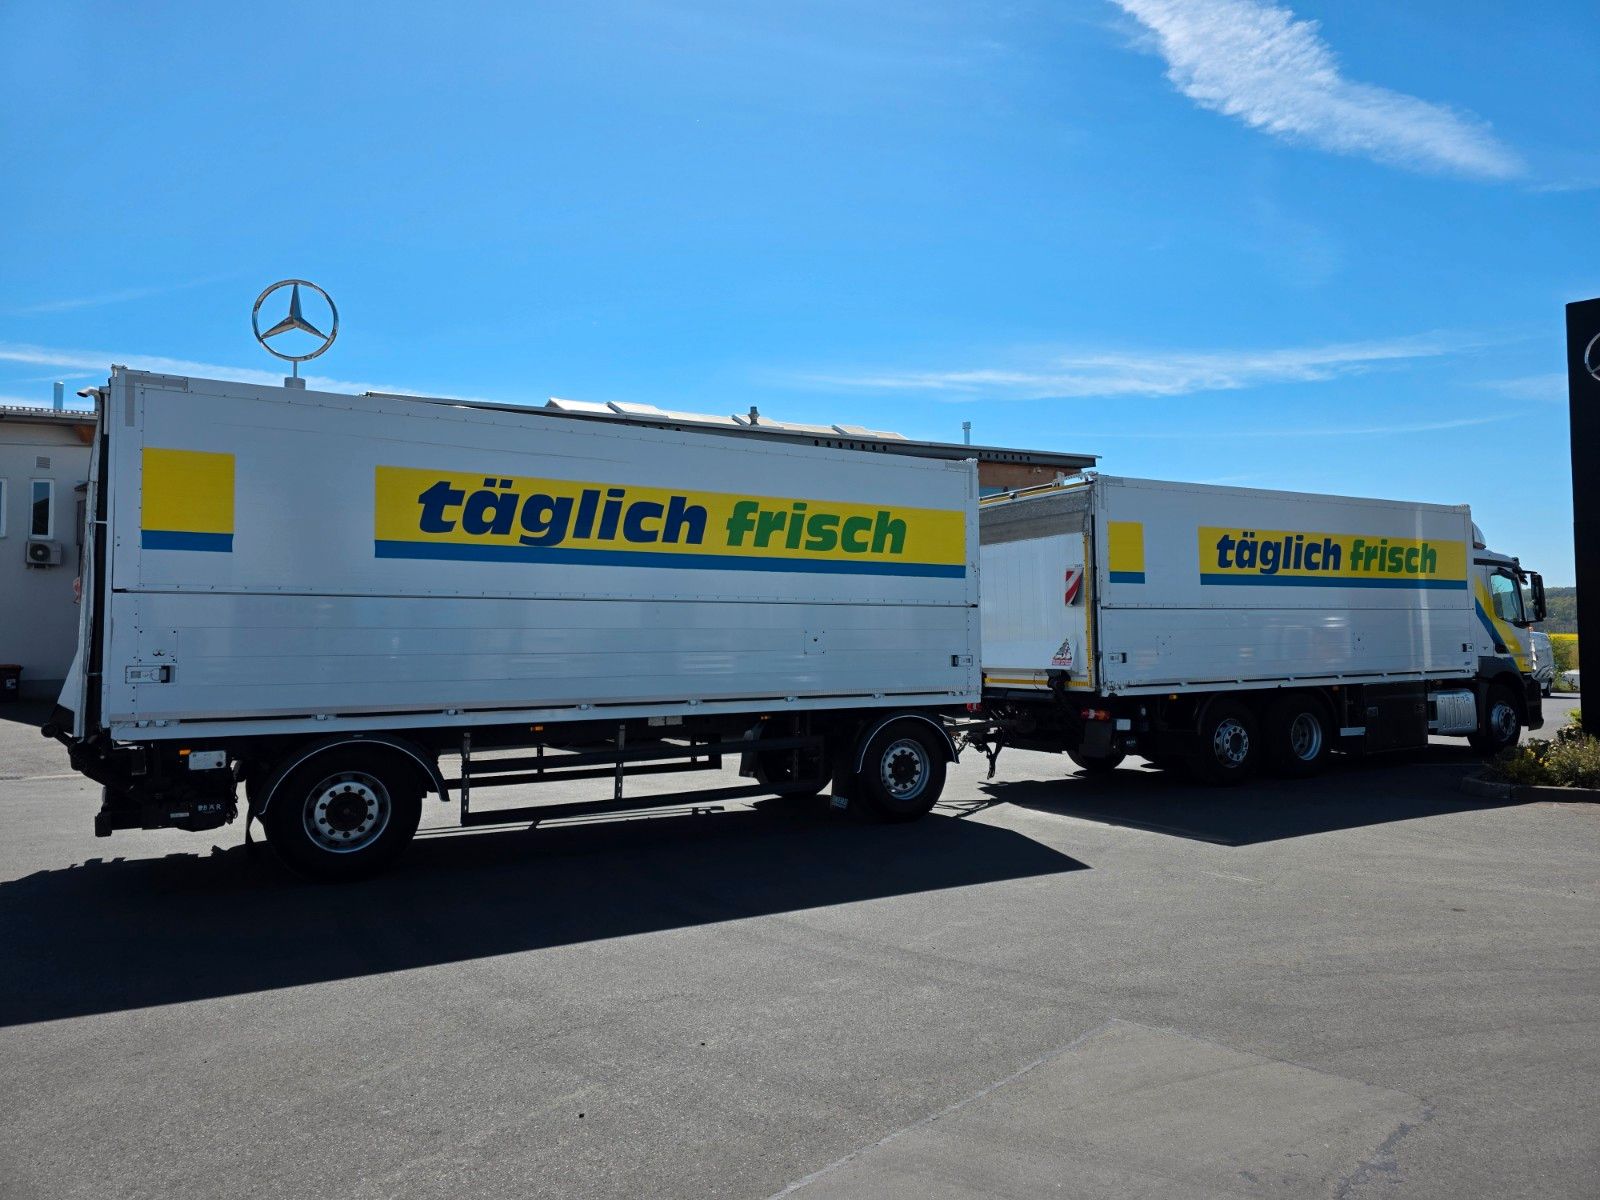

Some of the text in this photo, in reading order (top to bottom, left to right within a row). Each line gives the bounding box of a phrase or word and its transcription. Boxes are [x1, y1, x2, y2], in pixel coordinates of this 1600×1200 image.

[418, 478, 907, 555] täglich frisch
[1217, 531, 1437, 574] täglich frisch
